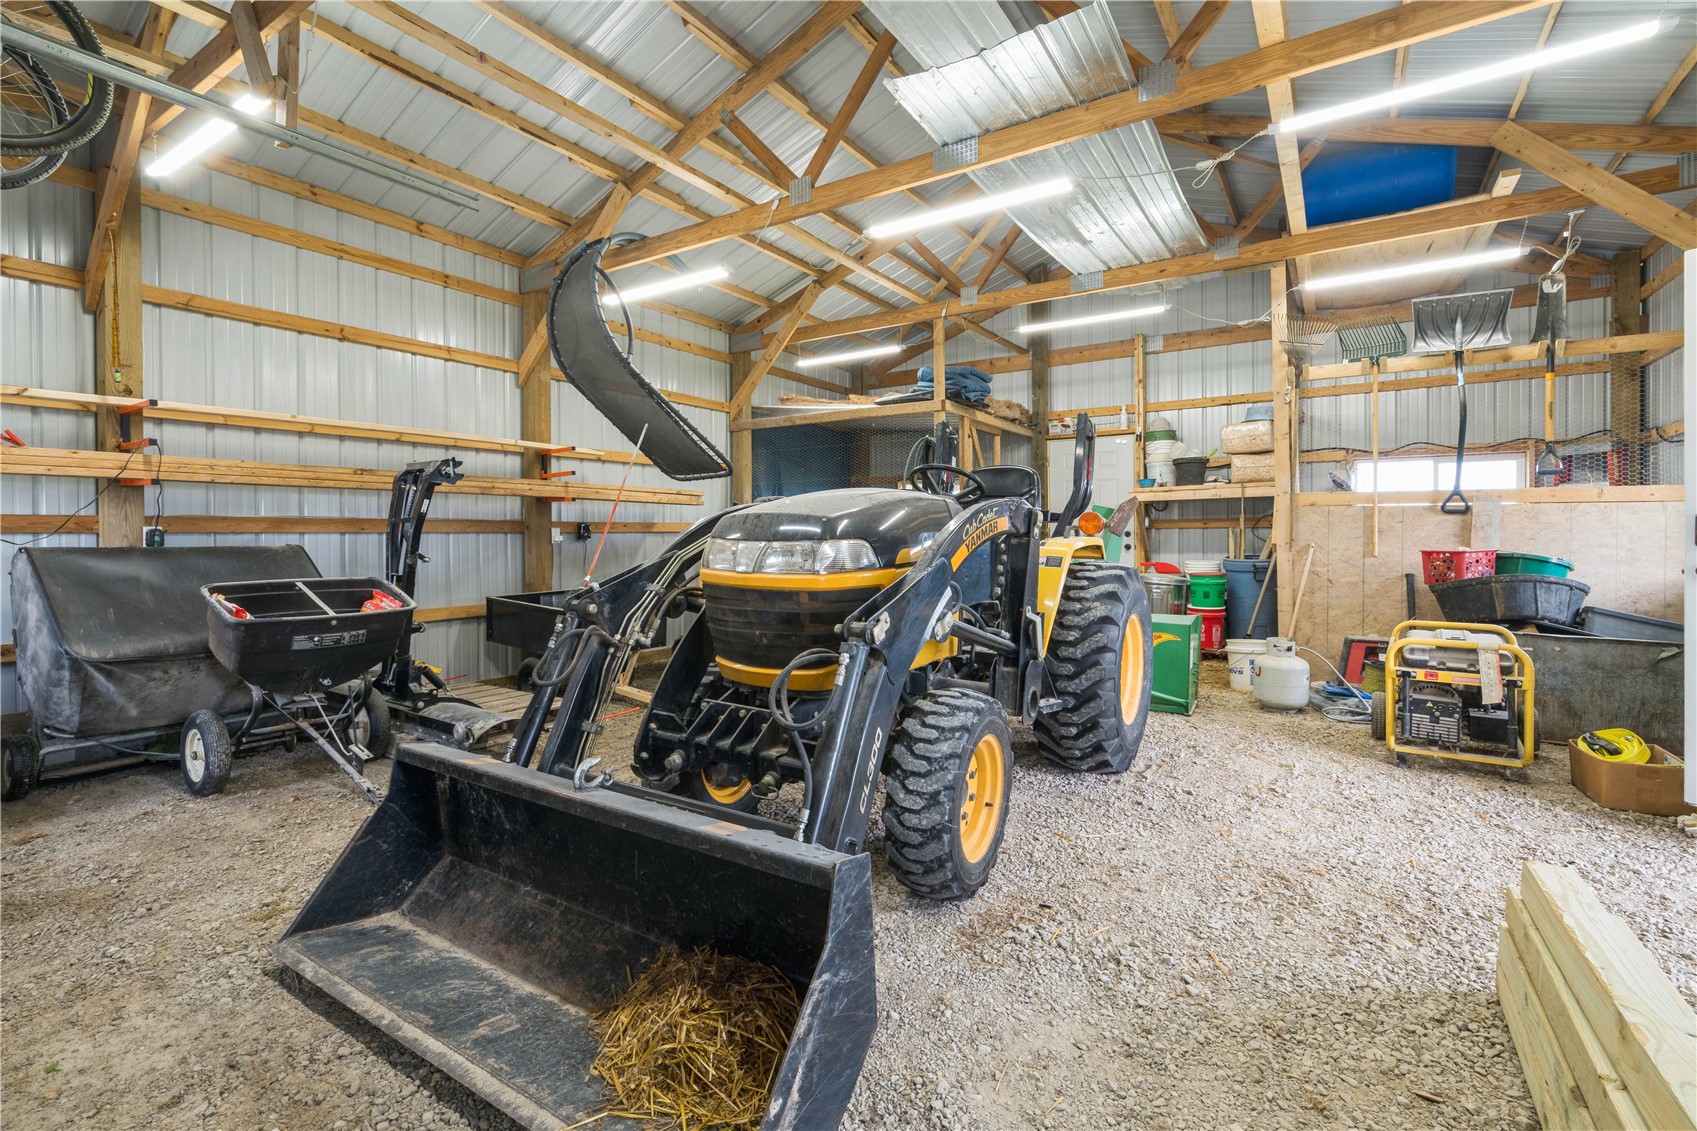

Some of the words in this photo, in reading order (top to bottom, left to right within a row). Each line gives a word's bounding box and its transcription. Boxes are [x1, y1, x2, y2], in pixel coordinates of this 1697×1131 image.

[963, 518, 977, 540] Cub
[976, 507, 999, 527] Cadet
[964, 520, 999, 553] YANMAR
[859, 726, 883, 815] CL300
